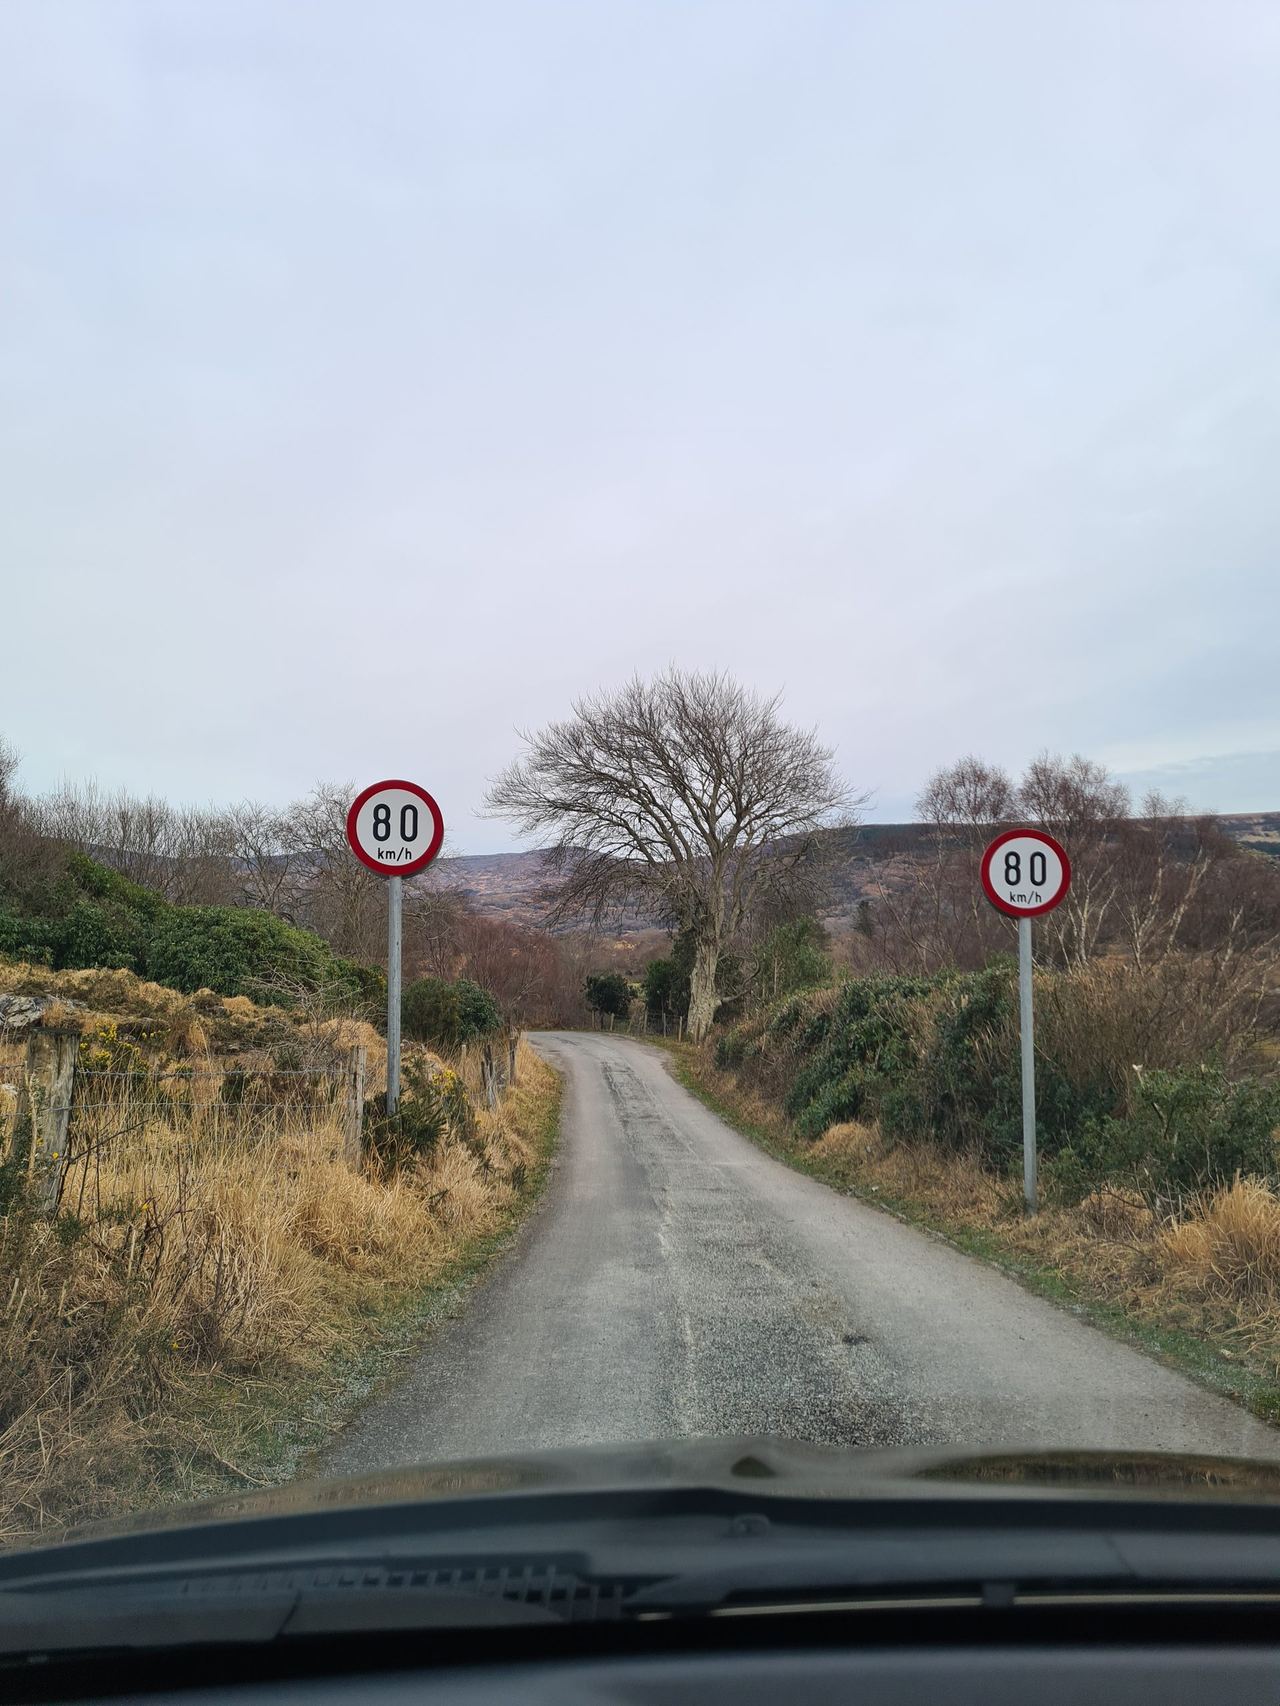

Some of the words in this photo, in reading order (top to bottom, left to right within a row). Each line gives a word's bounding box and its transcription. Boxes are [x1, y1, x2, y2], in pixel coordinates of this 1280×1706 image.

[373, 803, 418, 842] 80
[377, 847, 412, 861] km/h
[1004, 851, 1046, 886] 80
[1009, 891, 1042, 904] km/h
